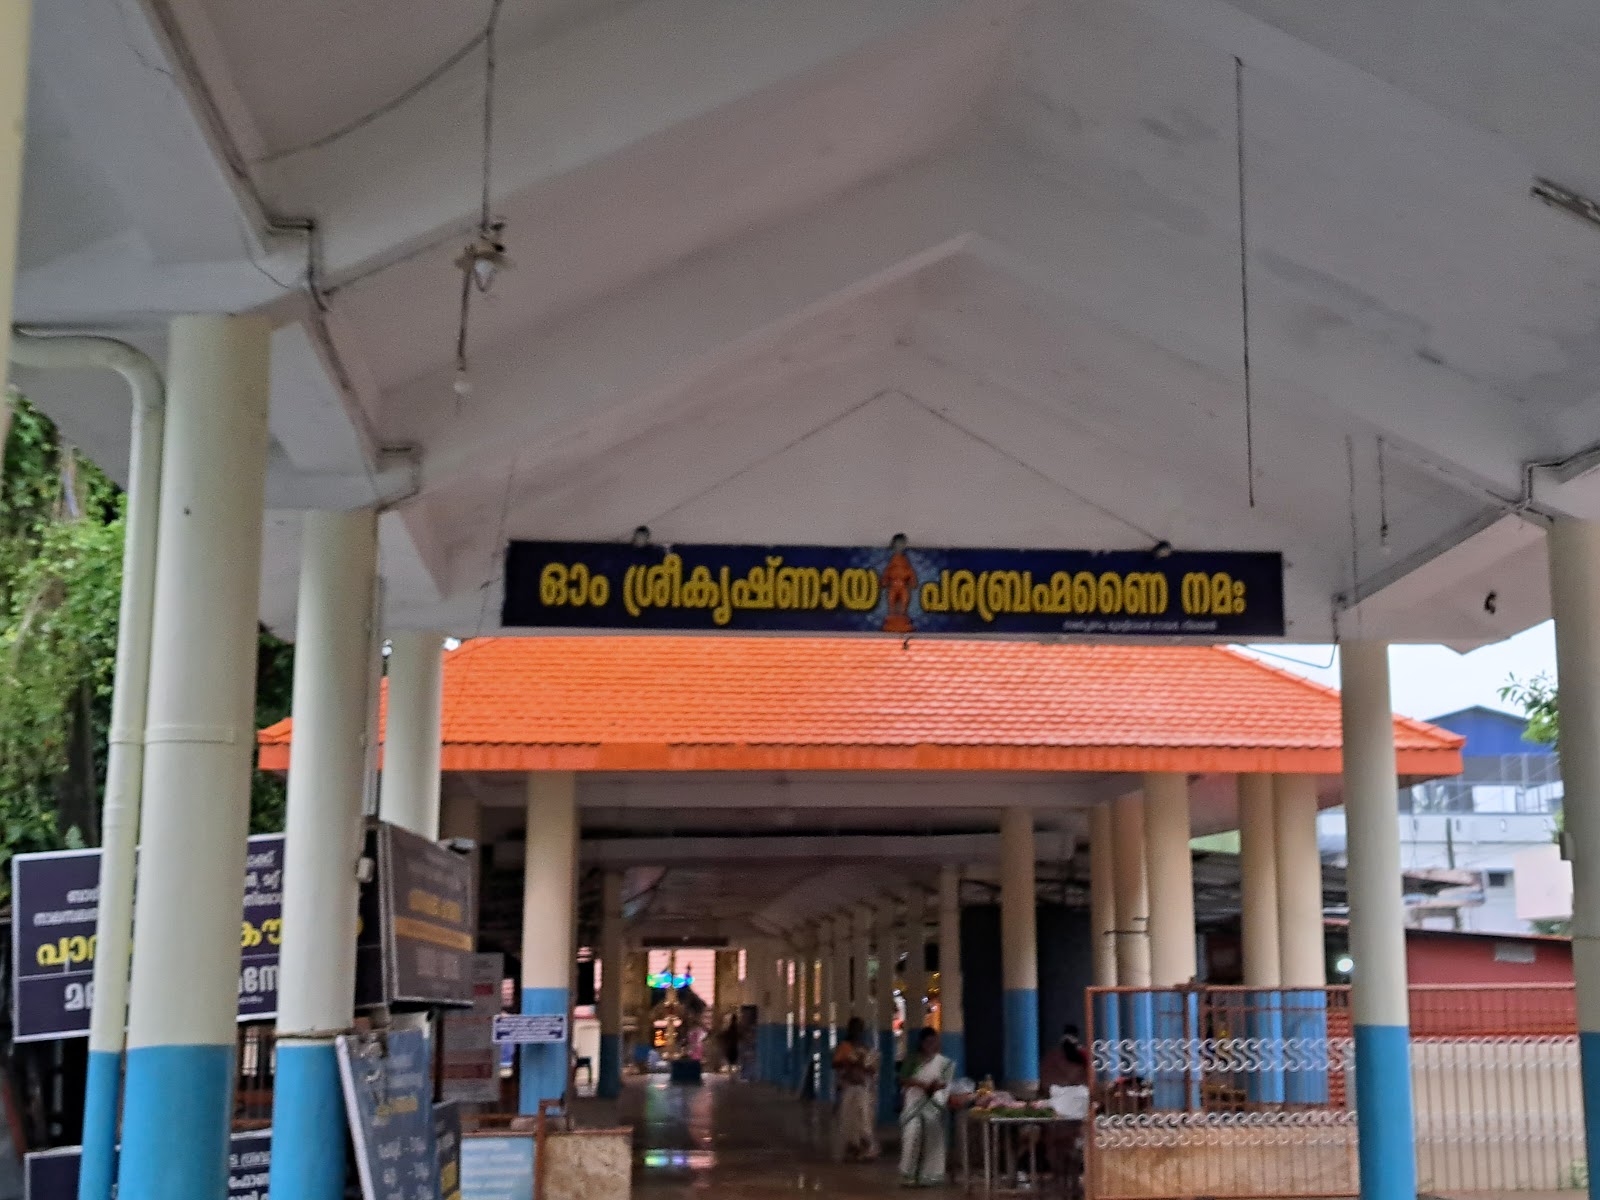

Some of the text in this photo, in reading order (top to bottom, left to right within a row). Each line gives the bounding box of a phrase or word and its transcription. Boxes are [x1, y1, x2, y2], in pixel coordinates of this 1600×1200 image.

[540, 563, 609, 606] ഓം
[623, 554, 879, 625] ശ്രീകൃഷ്ണായ
[1182, 572, 1245, 614] നമഃ
